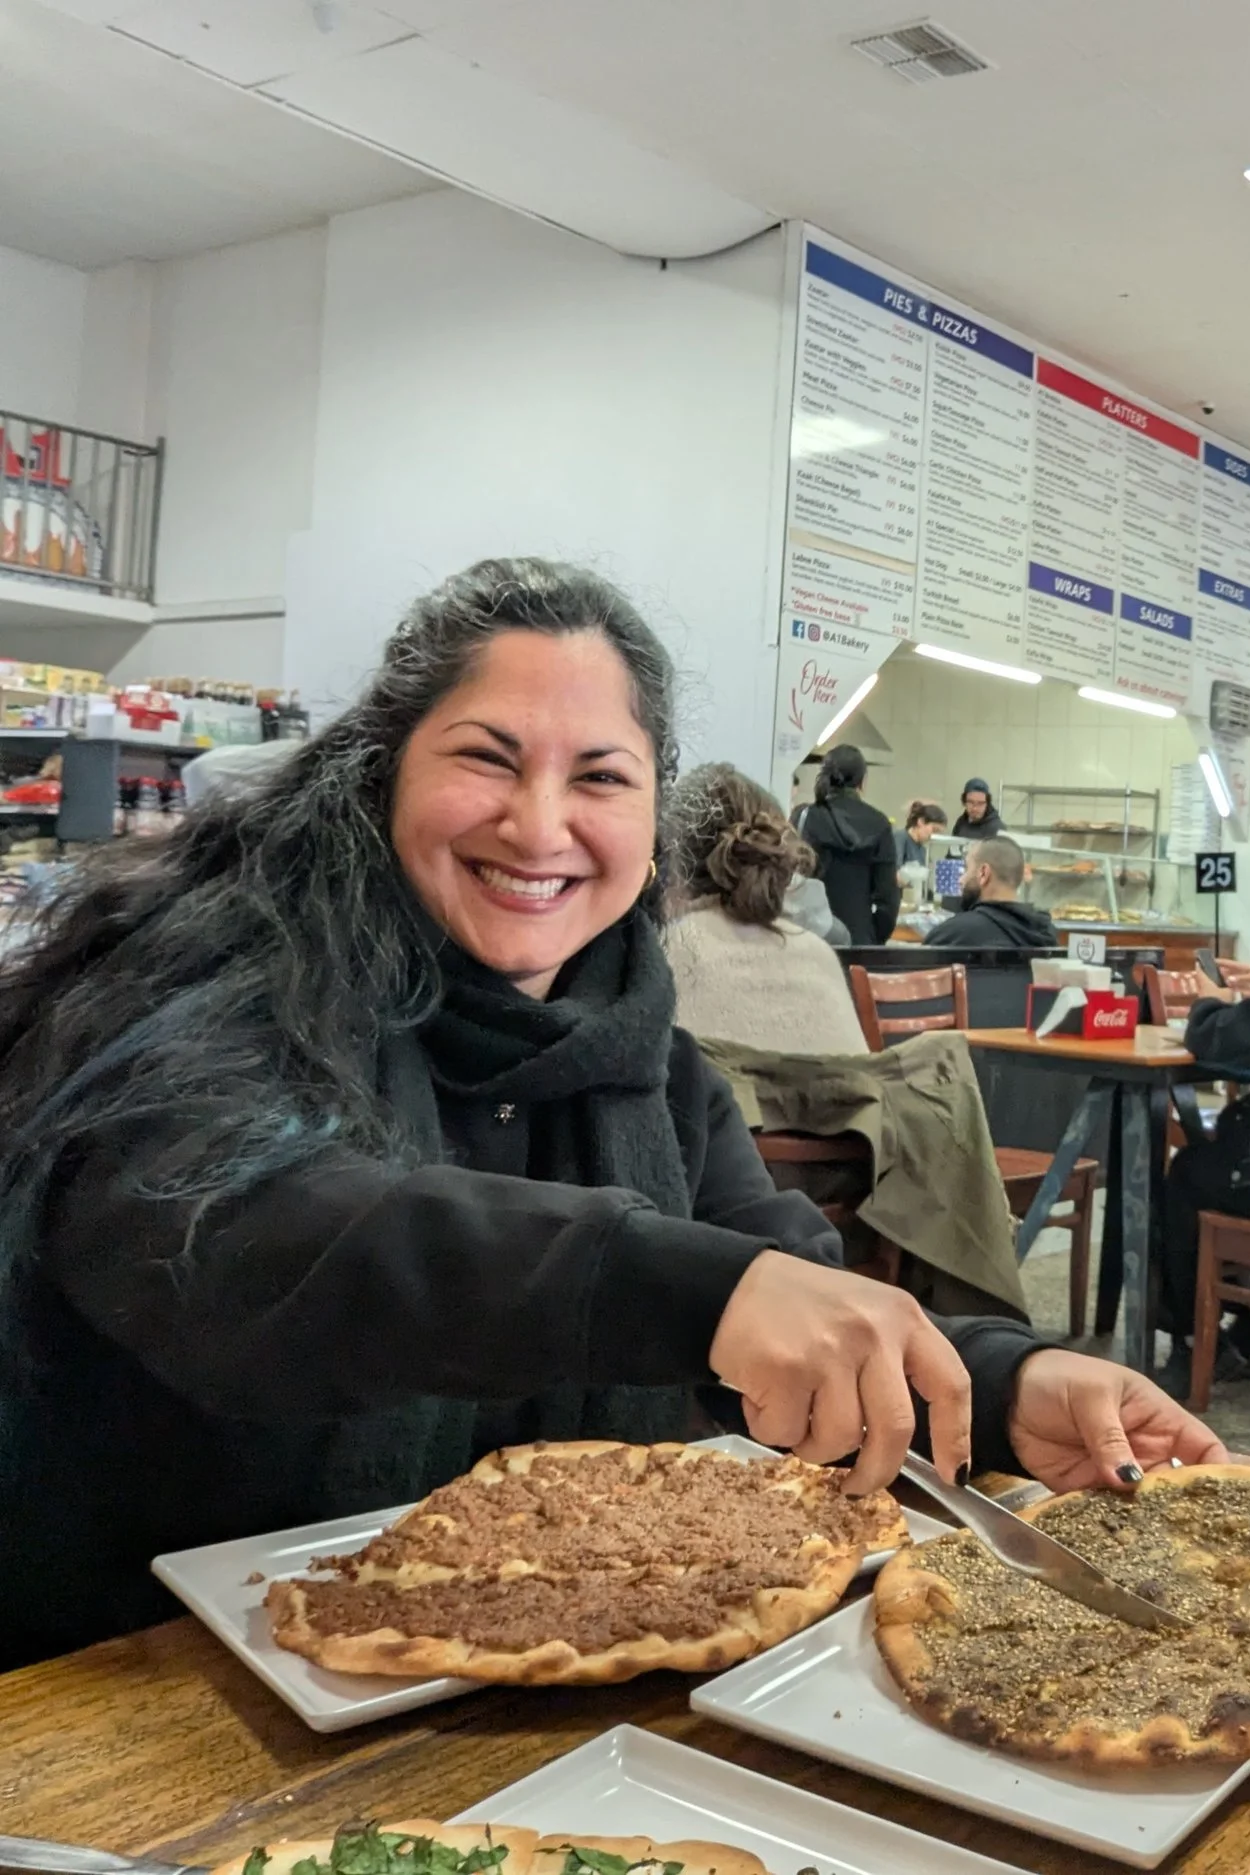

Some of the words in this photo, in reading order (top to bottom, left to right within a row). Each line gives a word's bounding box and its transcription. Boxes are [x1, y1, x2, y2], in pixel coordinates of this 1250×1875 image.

[884, 288, 913, 314] PIES
[917, 305, 928, 322] &
[932, 311, 978, 345] PIZZAS
[1102, 396, 1148, 429] PLATTERS
[1224, 458, 1248, 478] SIDES
[1054, 576, 1092, 602] WRAPS
[1214, 580, 1244, 602] EXTRAS
[1140, 606, 1175, 630] SALADS
[822, 630, 870, 654] @A1Bakery
[1200, 857, 1232, 888] 25
